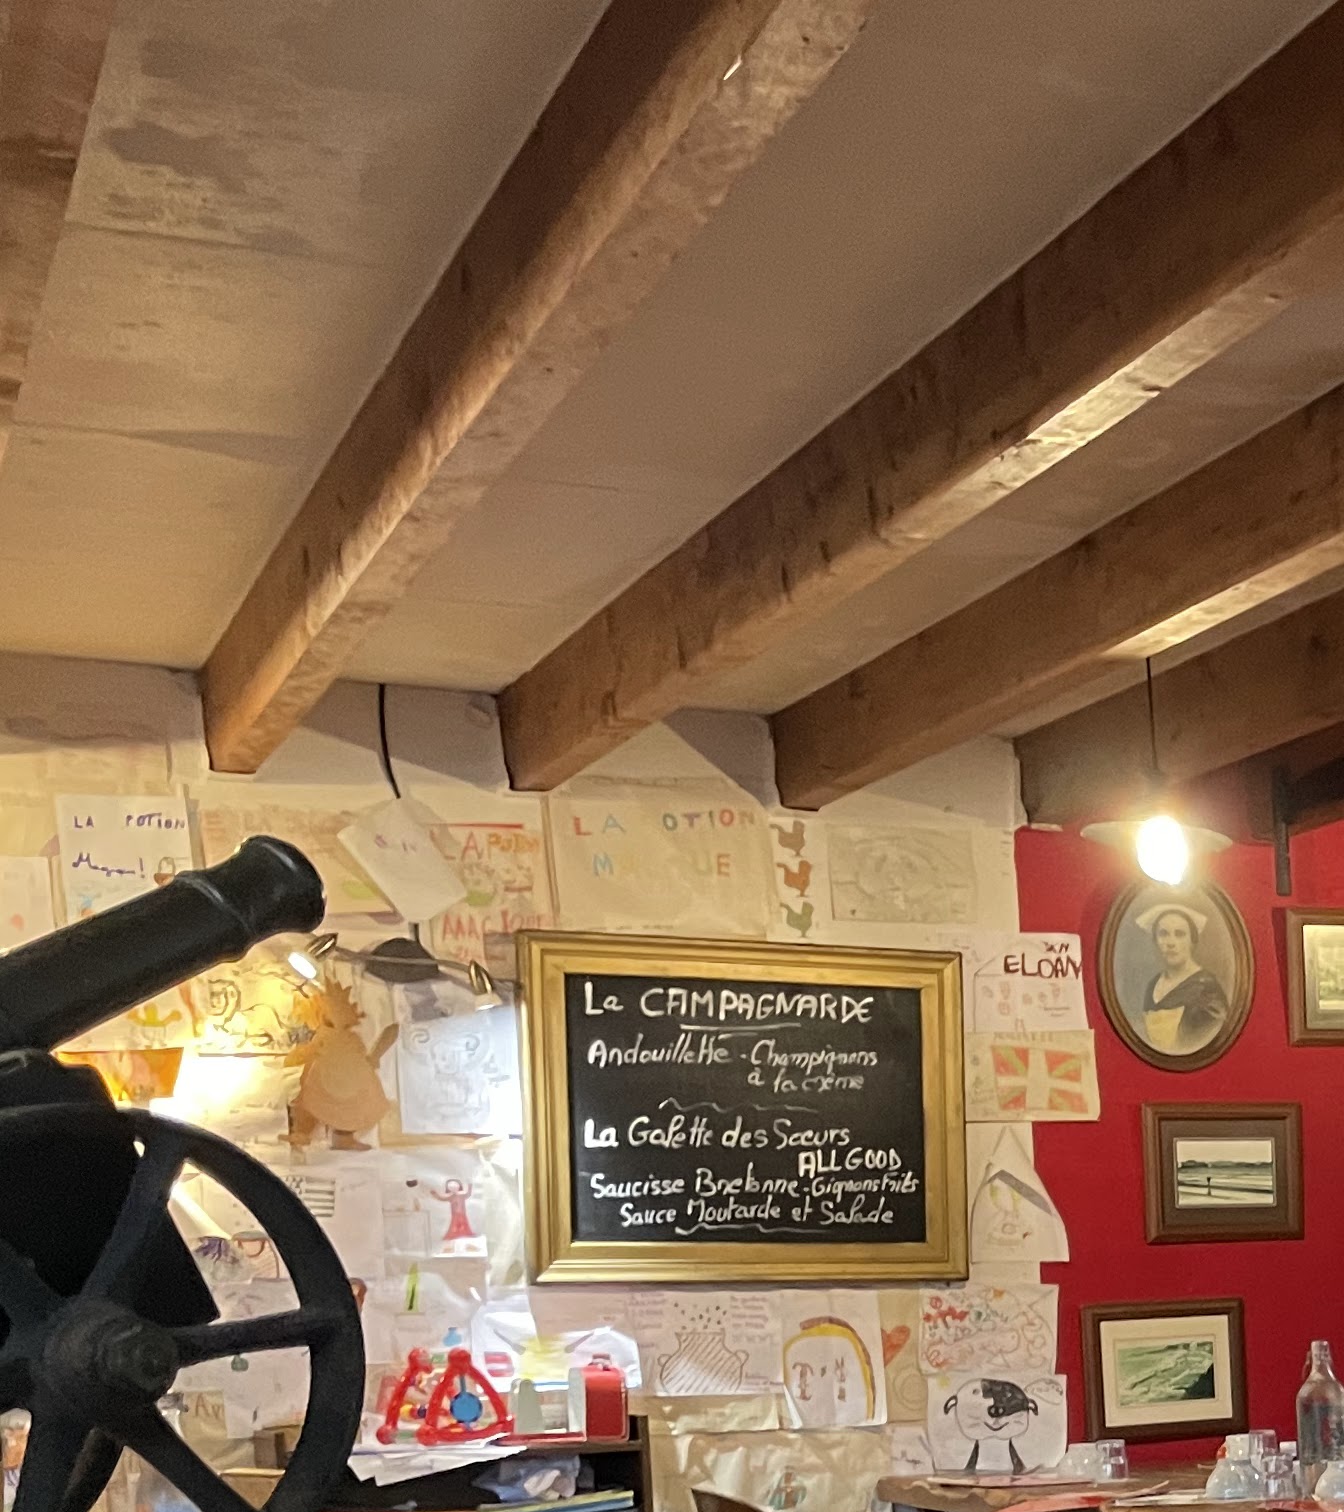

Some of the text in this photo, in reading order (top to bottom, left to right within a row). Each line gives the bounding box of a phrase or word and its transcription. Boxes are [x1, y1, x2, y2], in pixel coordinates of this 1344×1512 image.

[126, 812, 185, 830] POTION
[584, 981, 874, 1023] La CAMPAGNARDE
[750, 1038, 878, 1075] Champignons
[584, 1118, 619, 1149] La
[627, 1115, 711, 1149] Galette
[721, 1115, 768, 1148] des
[590, 1173, 685, 1199] Saucisse
[695, 1161, 798, 1197] Bretonne
[798, 1147, 902, 1179] ALL GOOD
[620, 1193, 894, 1226] Sauce Moutarde et Salade
